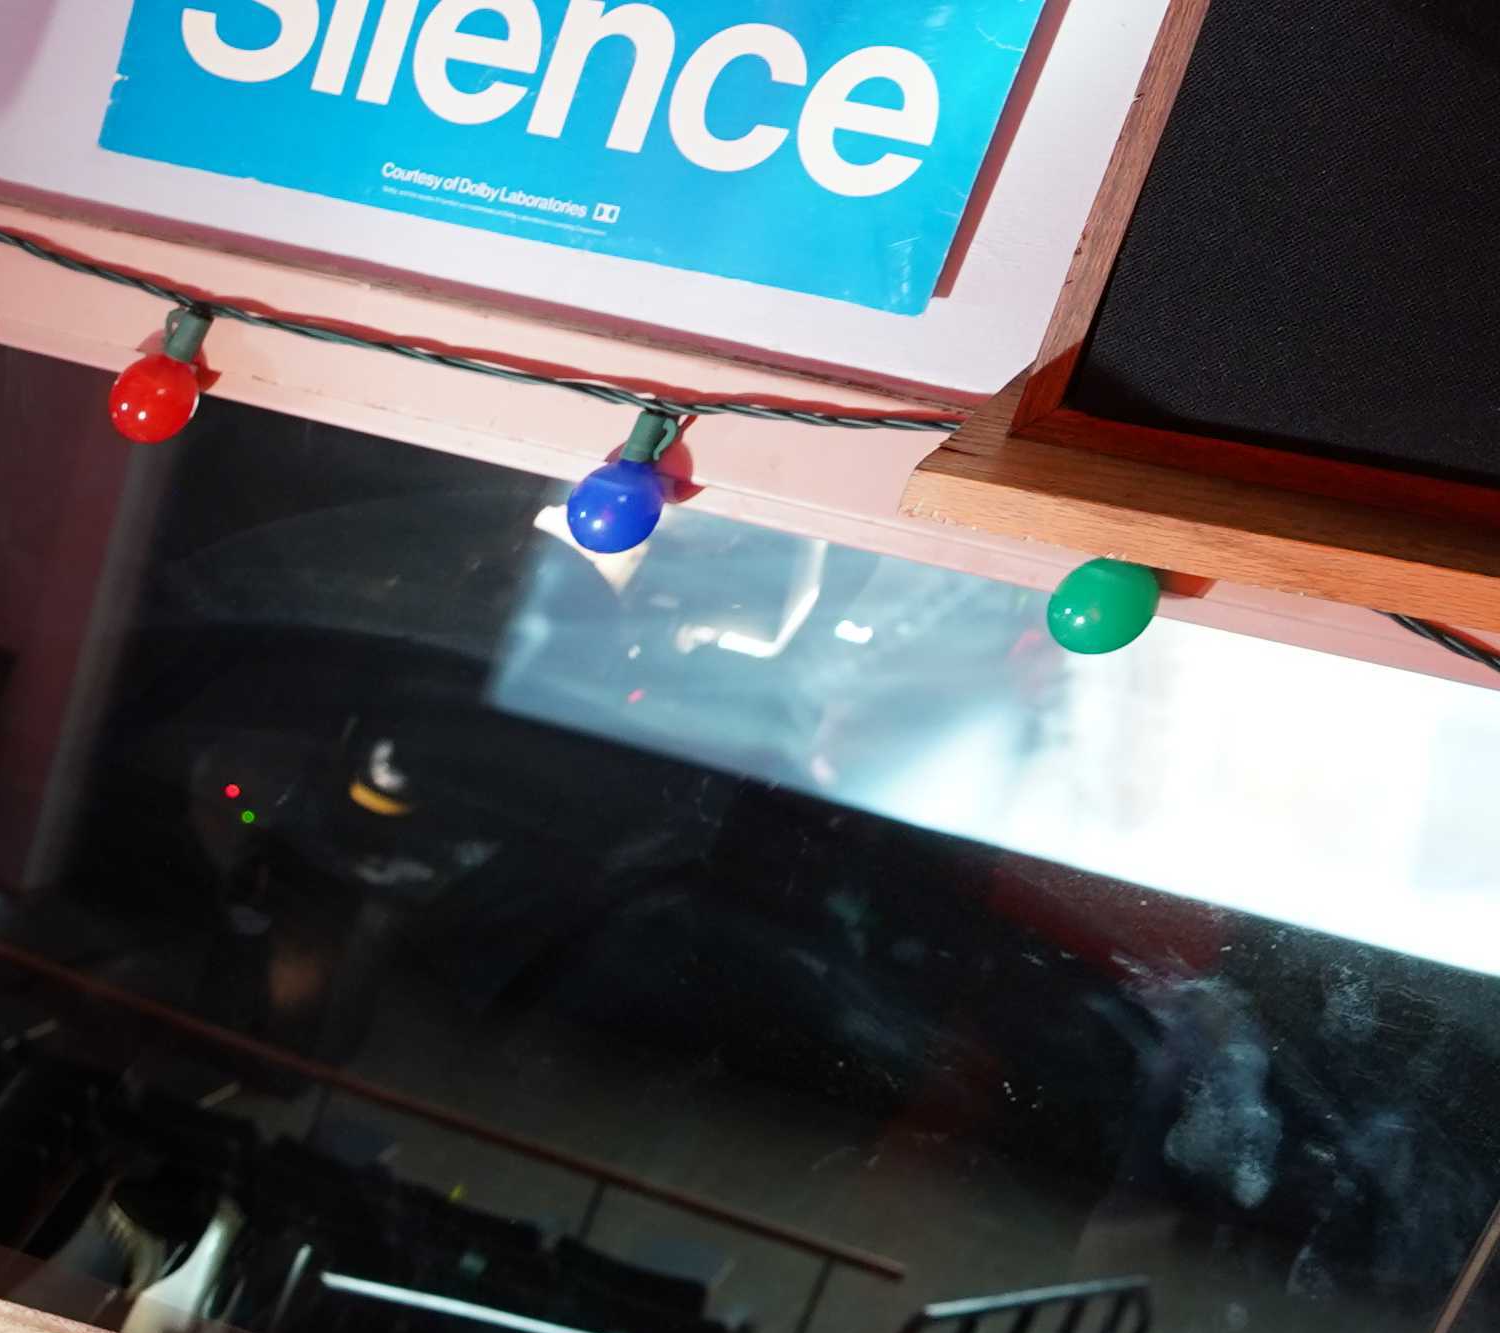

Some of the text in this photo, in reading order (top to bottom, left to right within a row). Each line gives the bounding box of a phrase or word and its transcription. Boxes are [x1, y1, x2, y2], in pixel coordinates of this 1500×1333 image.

[381, 161, 442, 190] Courtesy
[443, 175, 460, 191] of
[459, 178, 501, 201] Dolby
[500, 186, 588, 218] Laboratories
